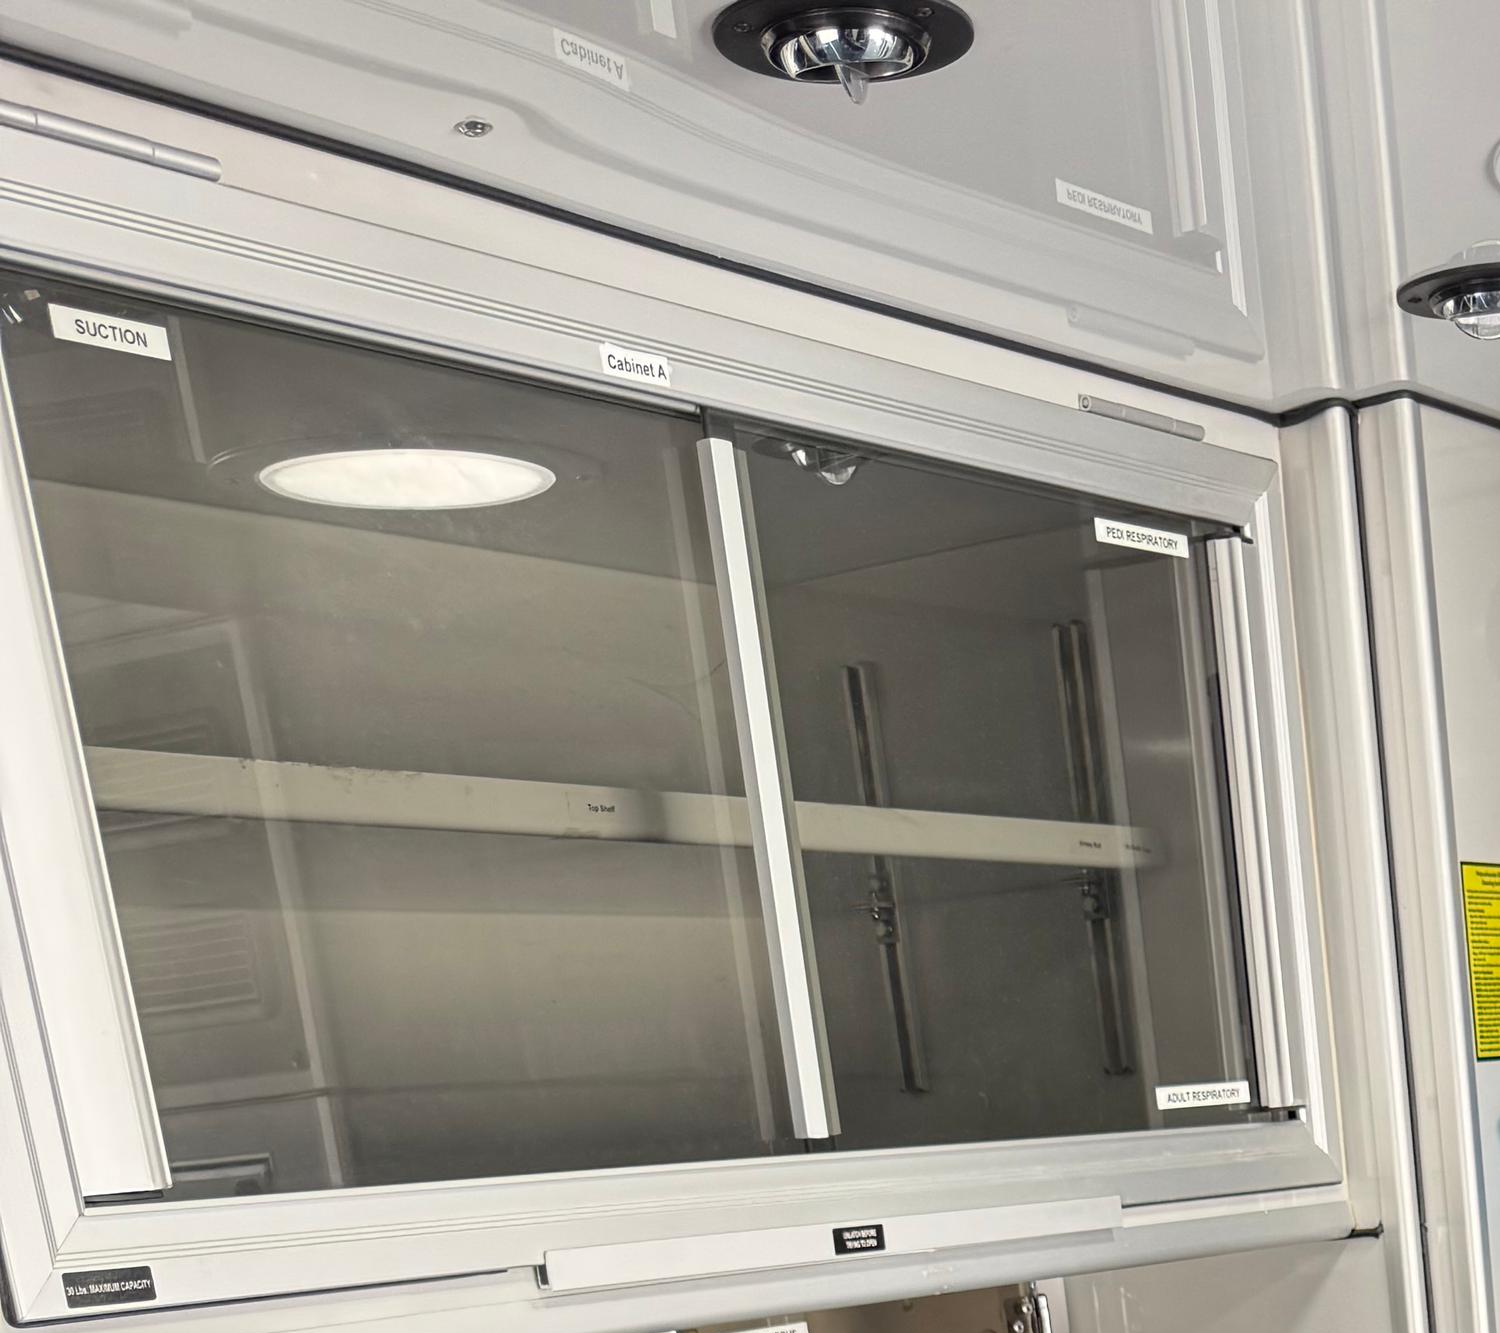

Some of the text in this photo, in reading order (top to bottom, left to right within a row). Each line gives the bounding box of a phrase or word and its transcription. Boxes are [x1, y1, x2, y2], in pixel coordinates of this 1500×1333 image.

[75, 318, 148, 348] SUCTION
[607, 353, 668, 381] Cabinet A
[1106, 526, 1179, 551] PEDI RESPIRATORY
[1193, 1088, 1241, 1102] RESPIRATORY
[89, 1281, 121, 1295] MAXIMUM
[121, 1279, 151, 1291] CAPACITY
